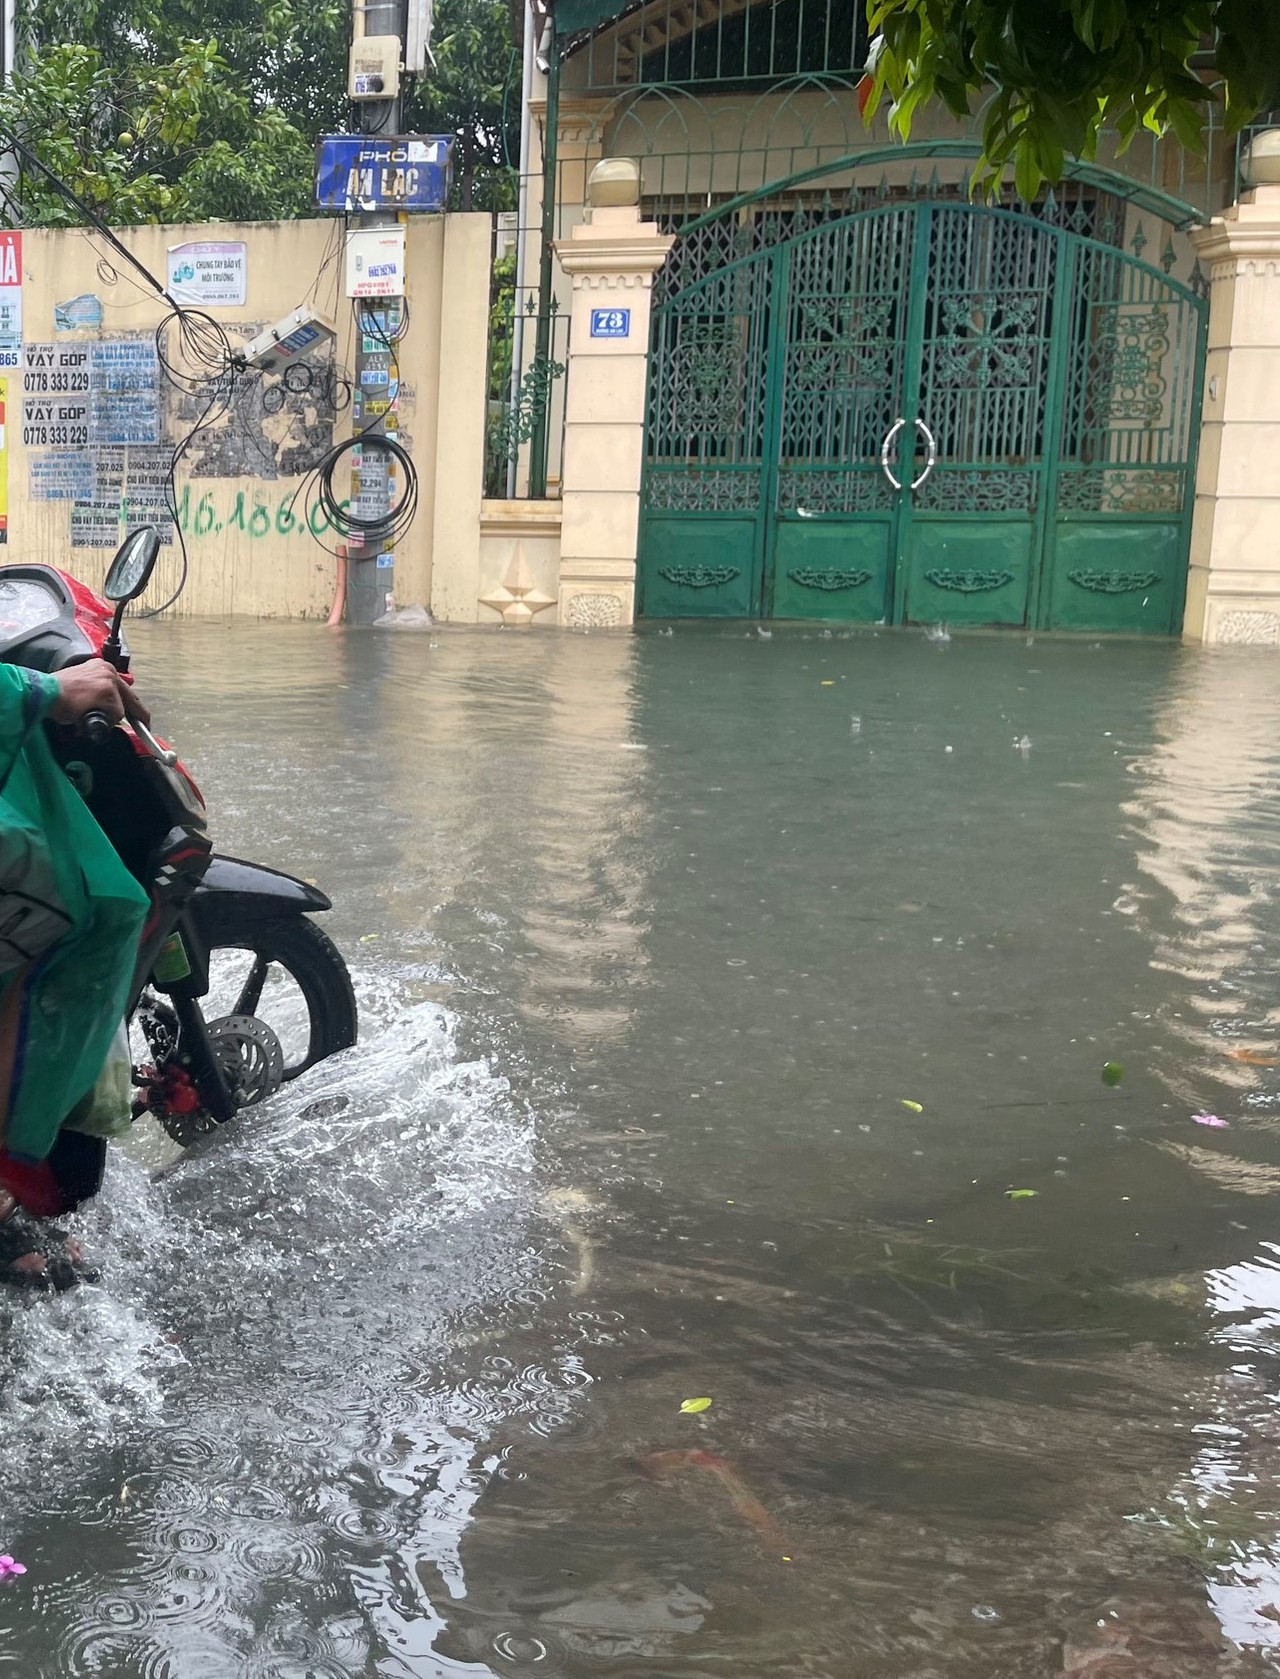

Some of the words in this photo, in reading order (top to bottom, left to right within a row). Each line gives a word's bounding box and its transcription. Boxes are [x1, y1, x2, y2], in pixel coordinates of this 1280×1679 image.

[346, 167, 373, 196] AN
[381, 167, 419, 201] LẠC
[196, 260, 214, 270] CHUNG
[214, 260, 223, 269] TAY
[598, 312, 623, 328] 73
[27, 353, 55, 367] VAY
[60, 351, 87, 366] GÓP
[24, 372, 48, 391] 0778
[51, 372, 68, 391] 333
[71, 372, 89, 391] 229
[25, 408, 53, 420] VAY
[59, 404, 86, 420] GÓP
[23, 426, 47, 445] 0778
[49, 426, 68, 444] 333
[70, 426, 88, 444] 229
